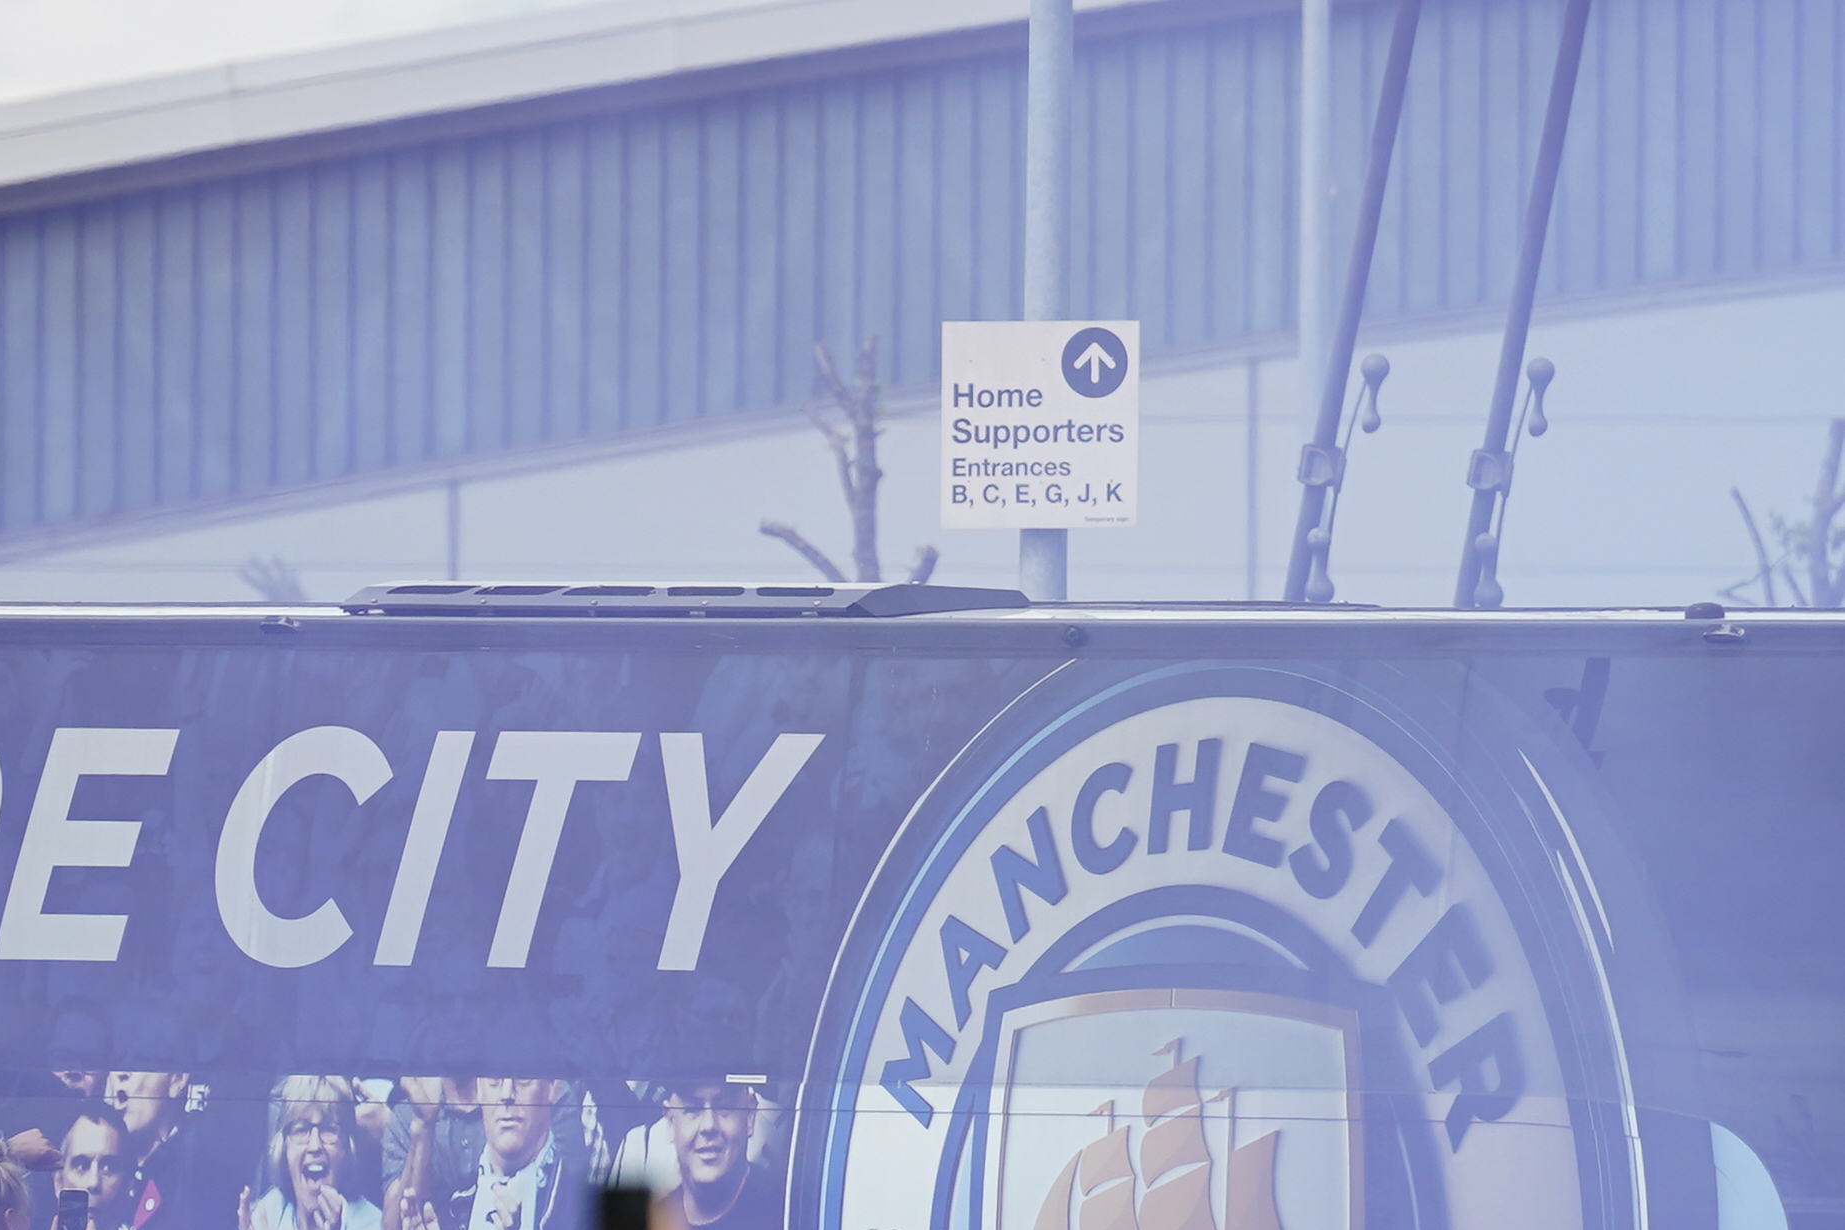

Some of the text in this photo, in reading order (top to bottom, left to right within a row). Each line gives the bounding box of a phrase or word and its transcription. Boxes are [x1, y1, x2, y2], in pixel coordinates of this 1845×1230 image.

[953, 383, 1043, 408] Home
[951, 418, 1125, 449] Supporters
[951, 458, 1072, 477] Entrances
[951, 482, 1123, 508] B, C, E, G, J, K
[213, 725, 826, 971] CITY
[878, 736, 1530, 1154] MANCHESTER
